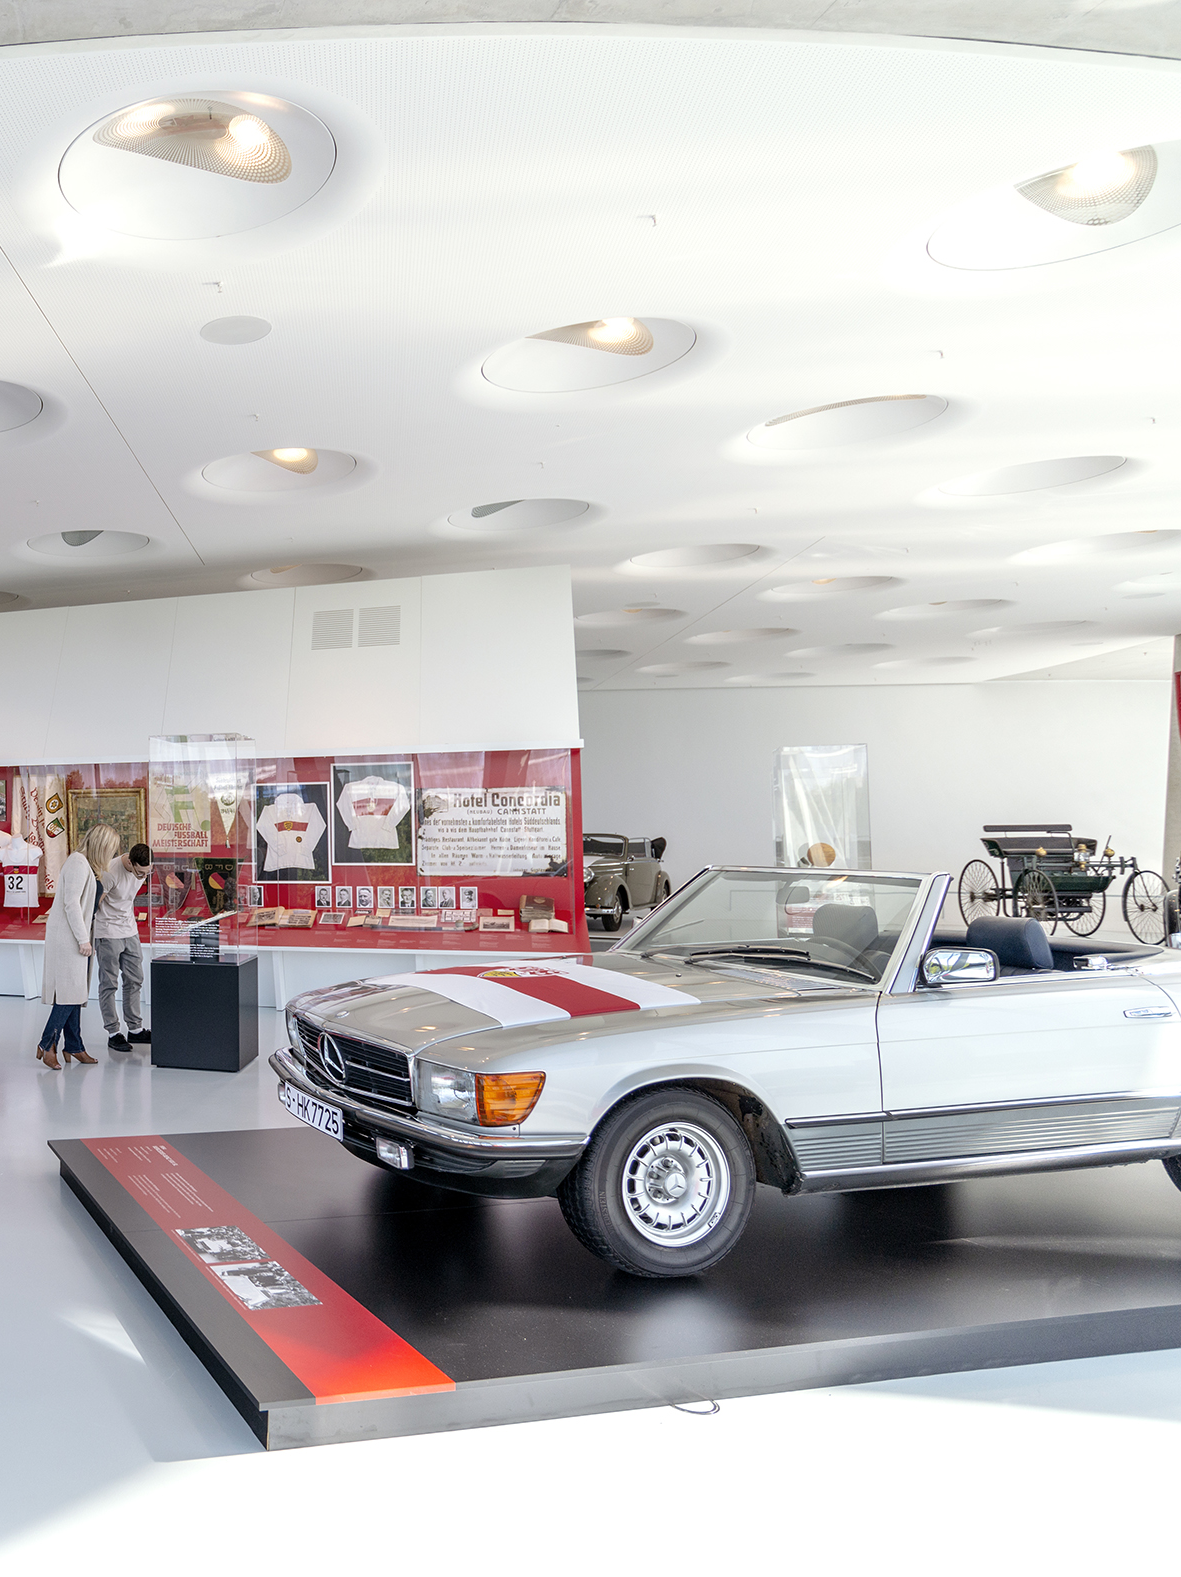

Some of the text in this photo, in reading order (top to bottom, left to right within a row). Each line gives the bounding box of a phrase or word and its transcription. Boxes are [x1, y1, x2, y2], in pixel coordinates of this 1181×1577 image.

[453, 791, 561, 808] Hotel Concordia
[157, 823, 192, 831] DEUTSCHE
[174, 831, 208, 839] FUSSBALL
[152, 839, 209, 847] MEISTERSCHAFT
[7, 875, 24, 890] 32
